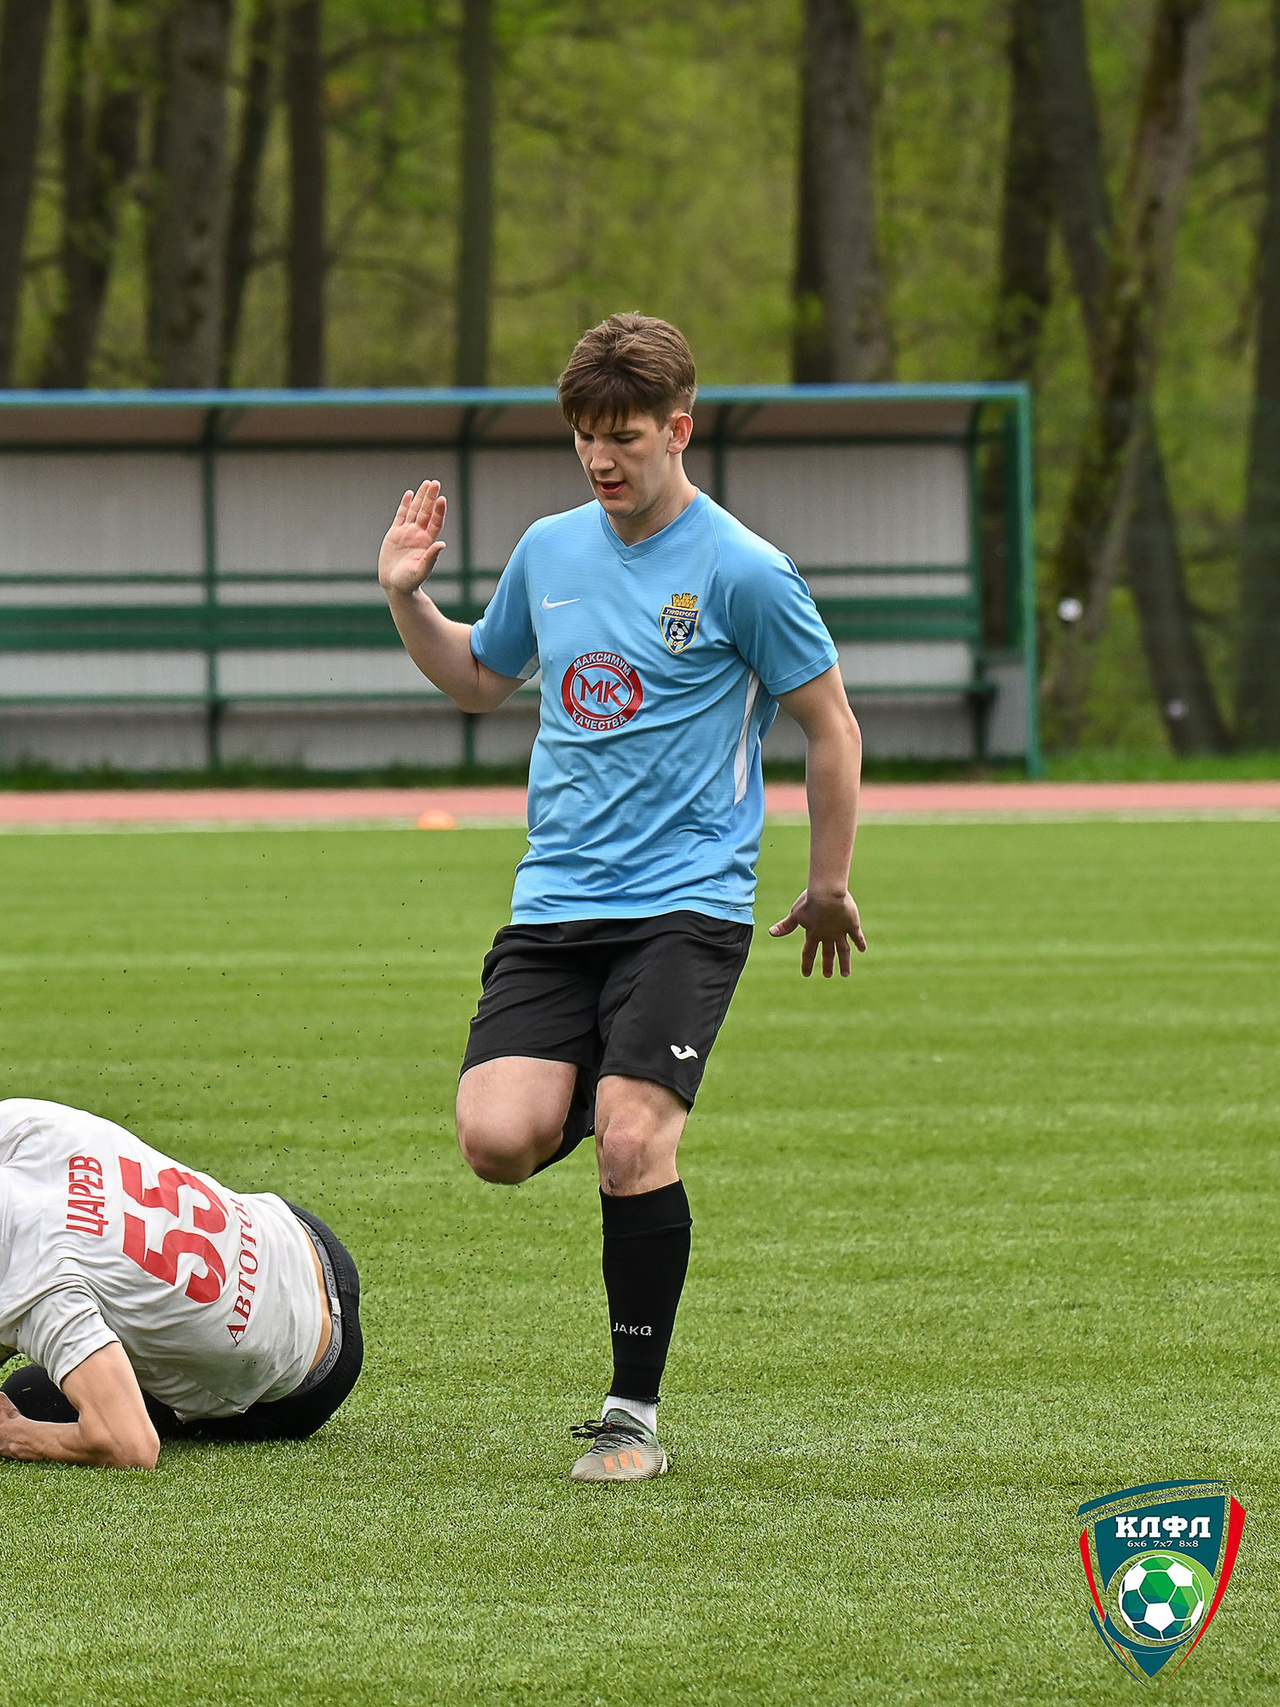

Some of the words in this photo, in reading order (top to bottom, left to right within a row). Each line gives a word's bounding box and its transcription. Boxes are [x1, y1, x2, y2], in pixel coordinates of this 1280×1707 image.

[573, 653, 632, 676] МАКСИМУМ
[576, 673, 626, 707] МК
[571, 710, 628, 730] КАЧЕСТВА
[66, 1155, 109, 1237] ЦАРЕВ
[118, 1155, 229, 1304] 55
[318, 1338, 339, 1377] SPORT
